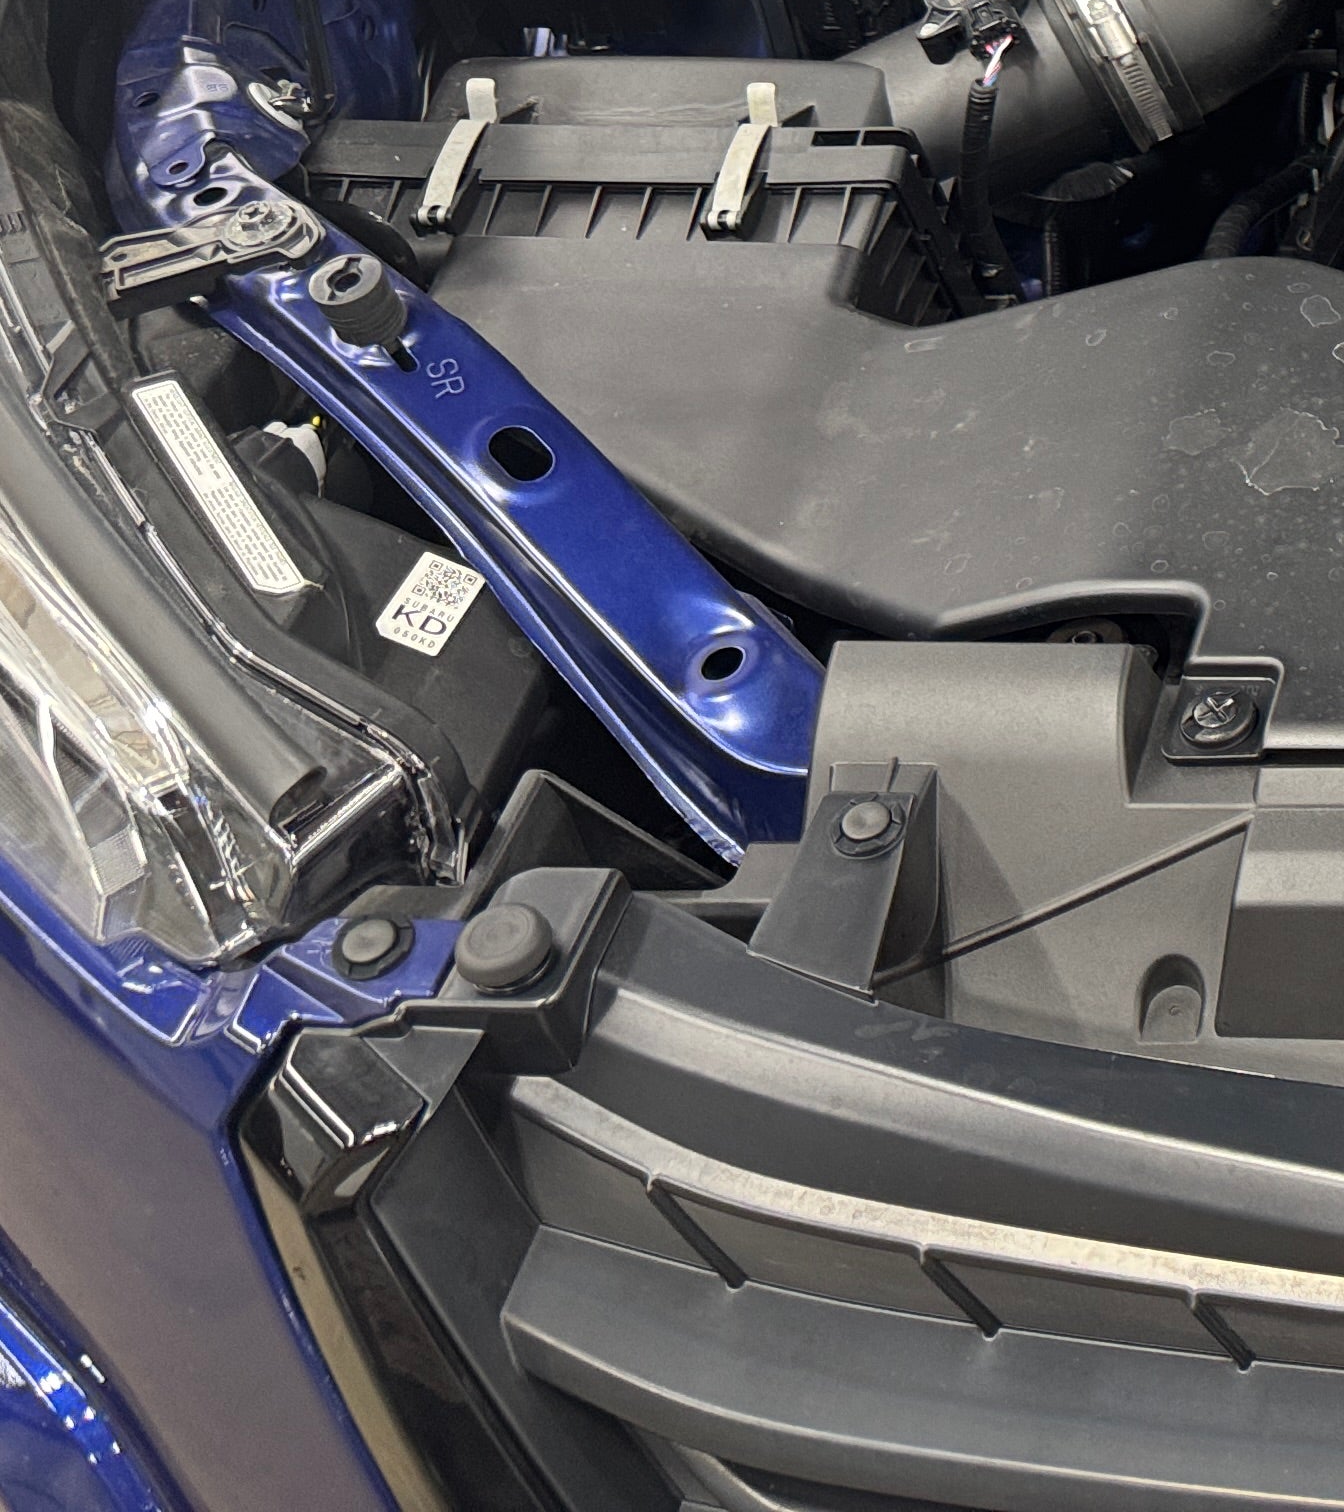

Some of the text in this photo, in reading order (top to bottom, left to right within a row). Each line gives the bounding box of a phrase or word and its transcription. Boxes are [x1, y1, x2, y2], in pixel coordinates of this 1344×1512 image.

[426, 357, 466, 399] SR
[392, 603, 448, 637] KD
[404, 596, 456, 622] SUBARU
